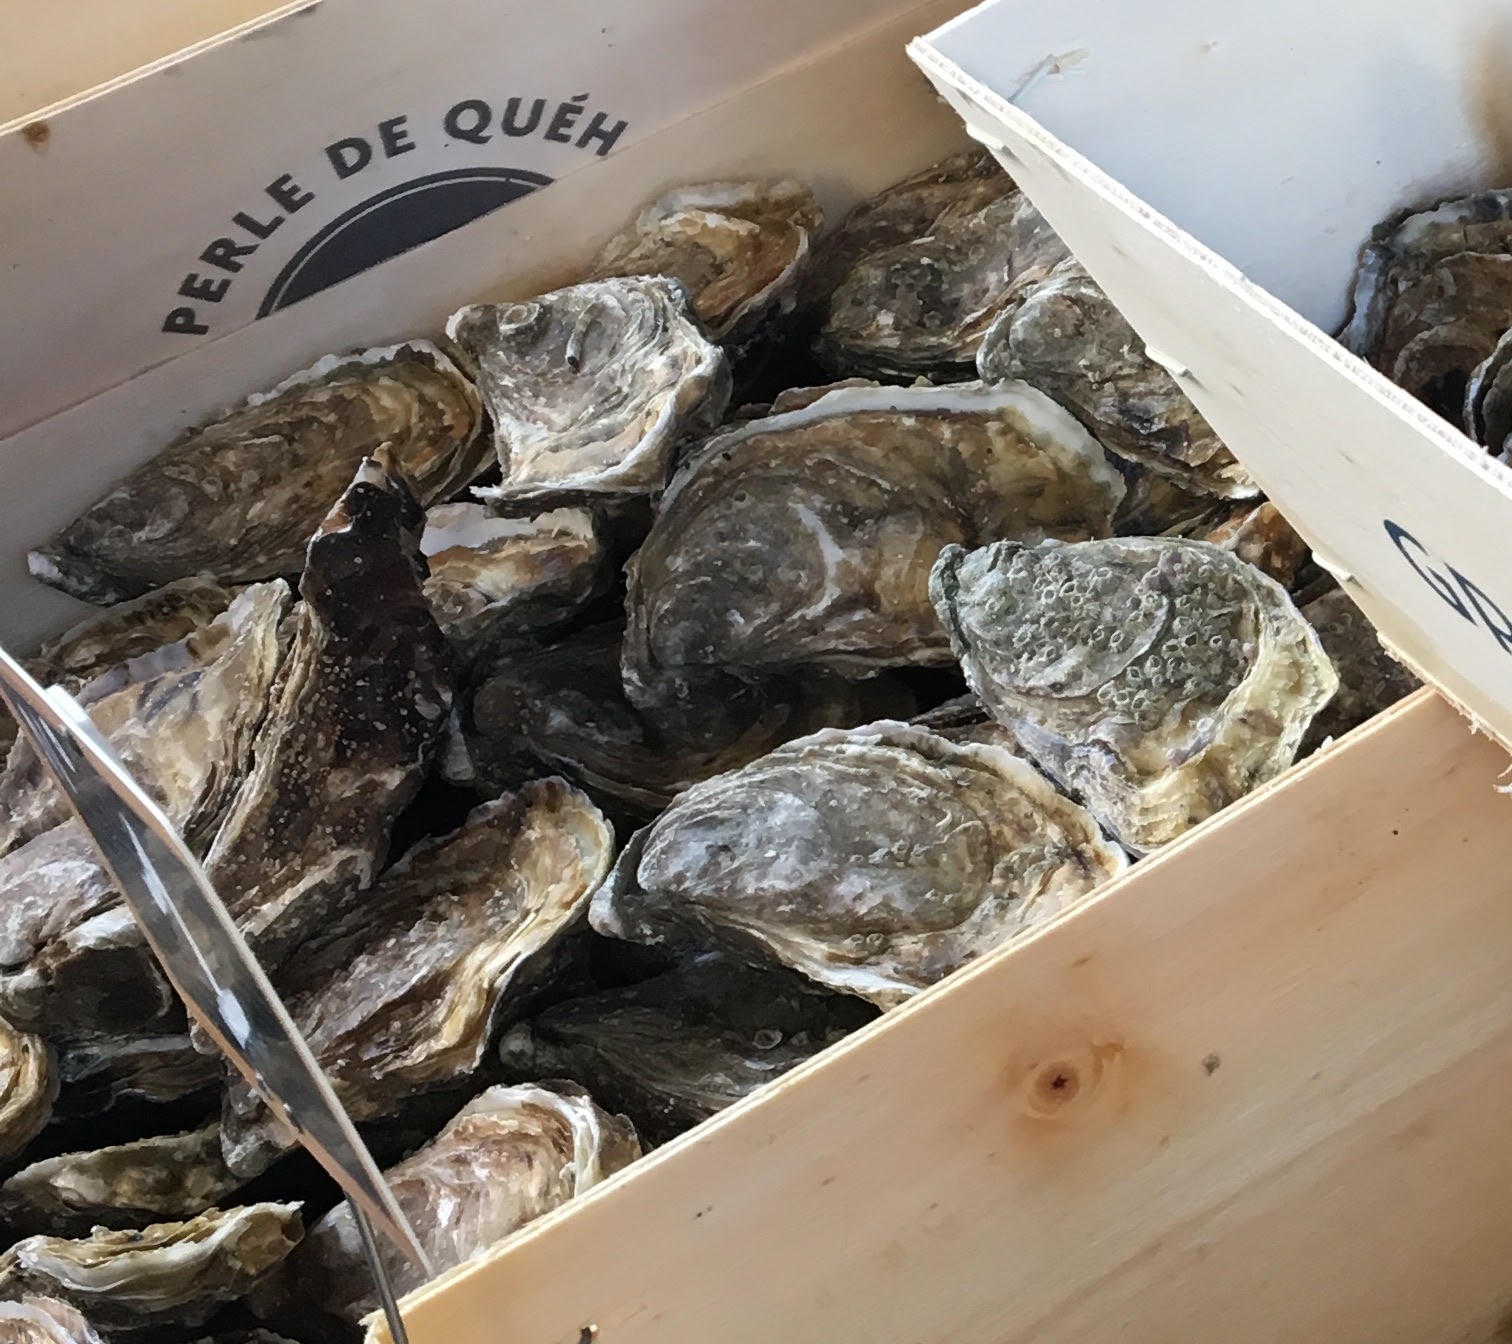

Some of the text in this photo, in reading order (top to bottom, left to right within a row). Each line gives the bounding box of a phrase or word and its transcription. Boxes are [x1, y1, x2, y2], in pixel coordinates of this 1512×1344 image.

[161, 92, 629, 336] PERLE DE QUÉH
